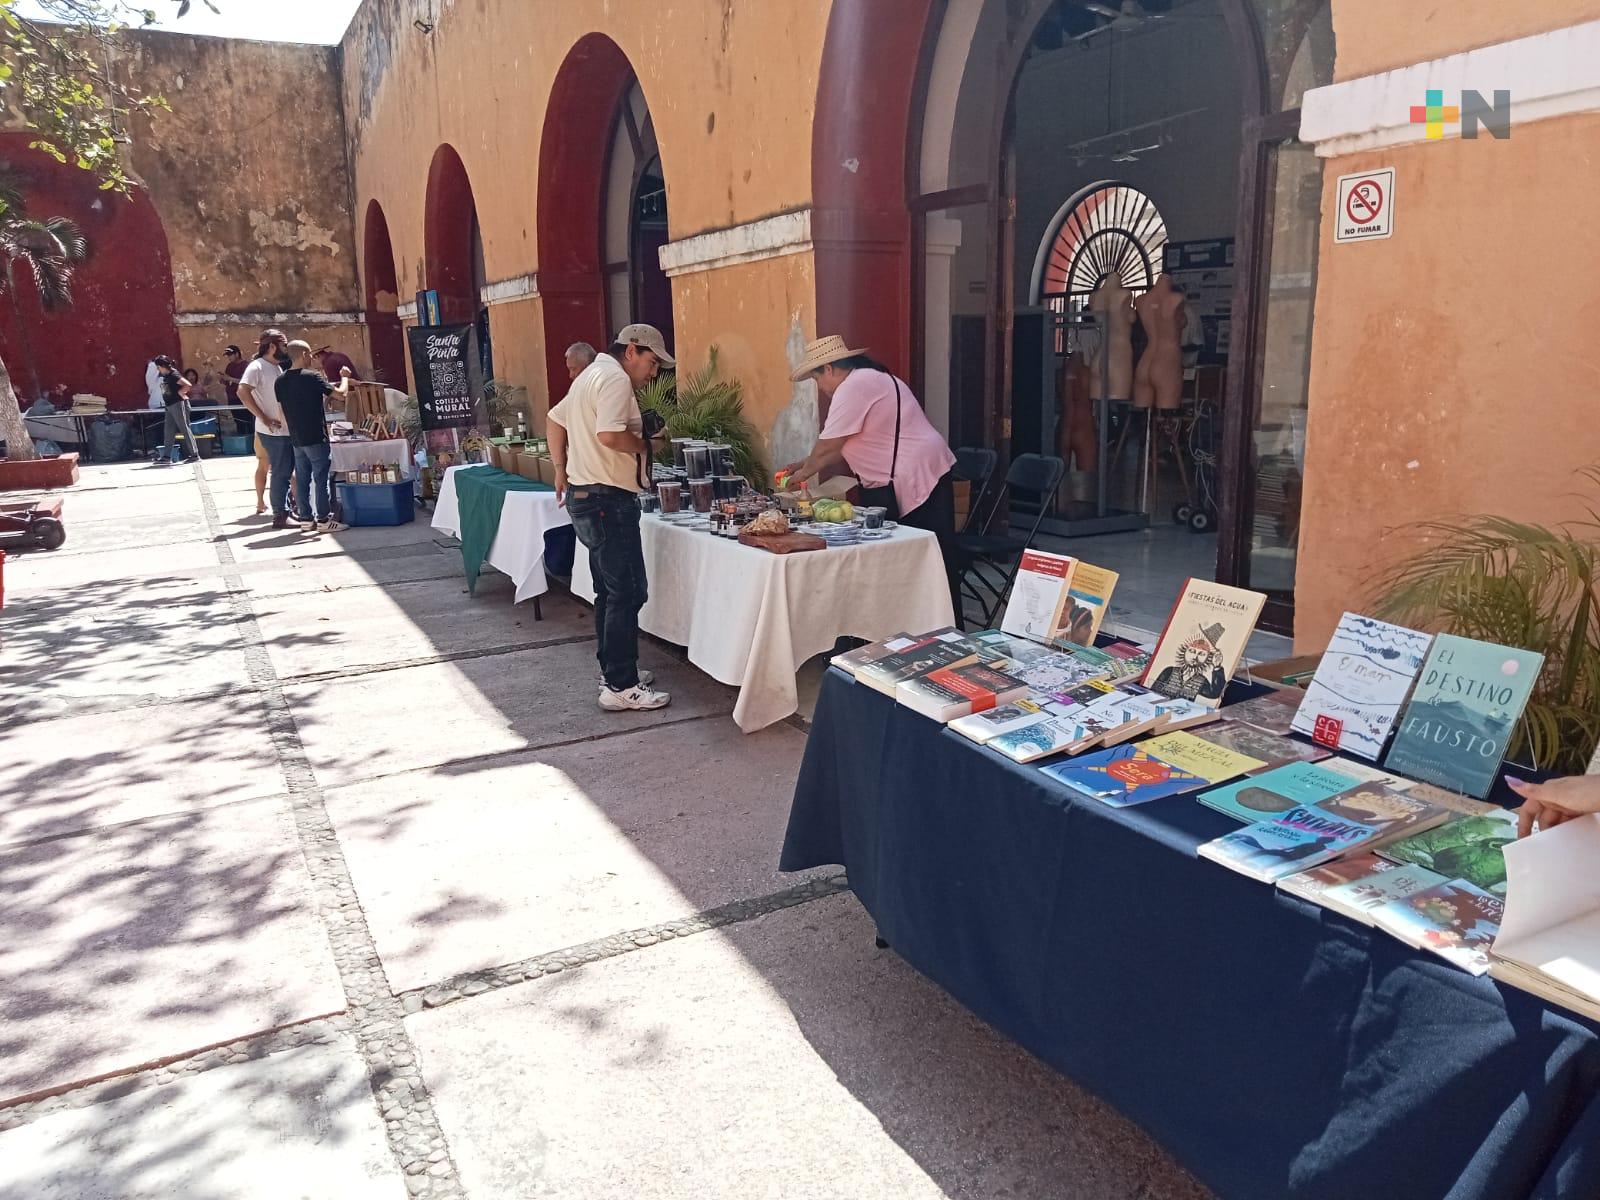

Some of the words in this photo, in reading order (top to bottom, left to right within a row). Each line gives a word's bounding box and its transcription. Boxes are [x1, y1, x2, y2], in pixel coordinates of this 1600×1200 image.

[1357, 224, 1381, 233] FUMAR
[426, 334, 460, 349] Santa
[427, 346, 460, 360] Pinta
[435, 397, 460, 405] COTIZA
[435, 402, 471, 412] MURAL
[1215, 598, 1226, 606] DEL
[1437, 649, 1456, 665] EL
[1425, 669, 1513, 706] DESTINO
[1427, 692, 1442, 707] de
[1405, 717, 1497, 758] FAUSTO
